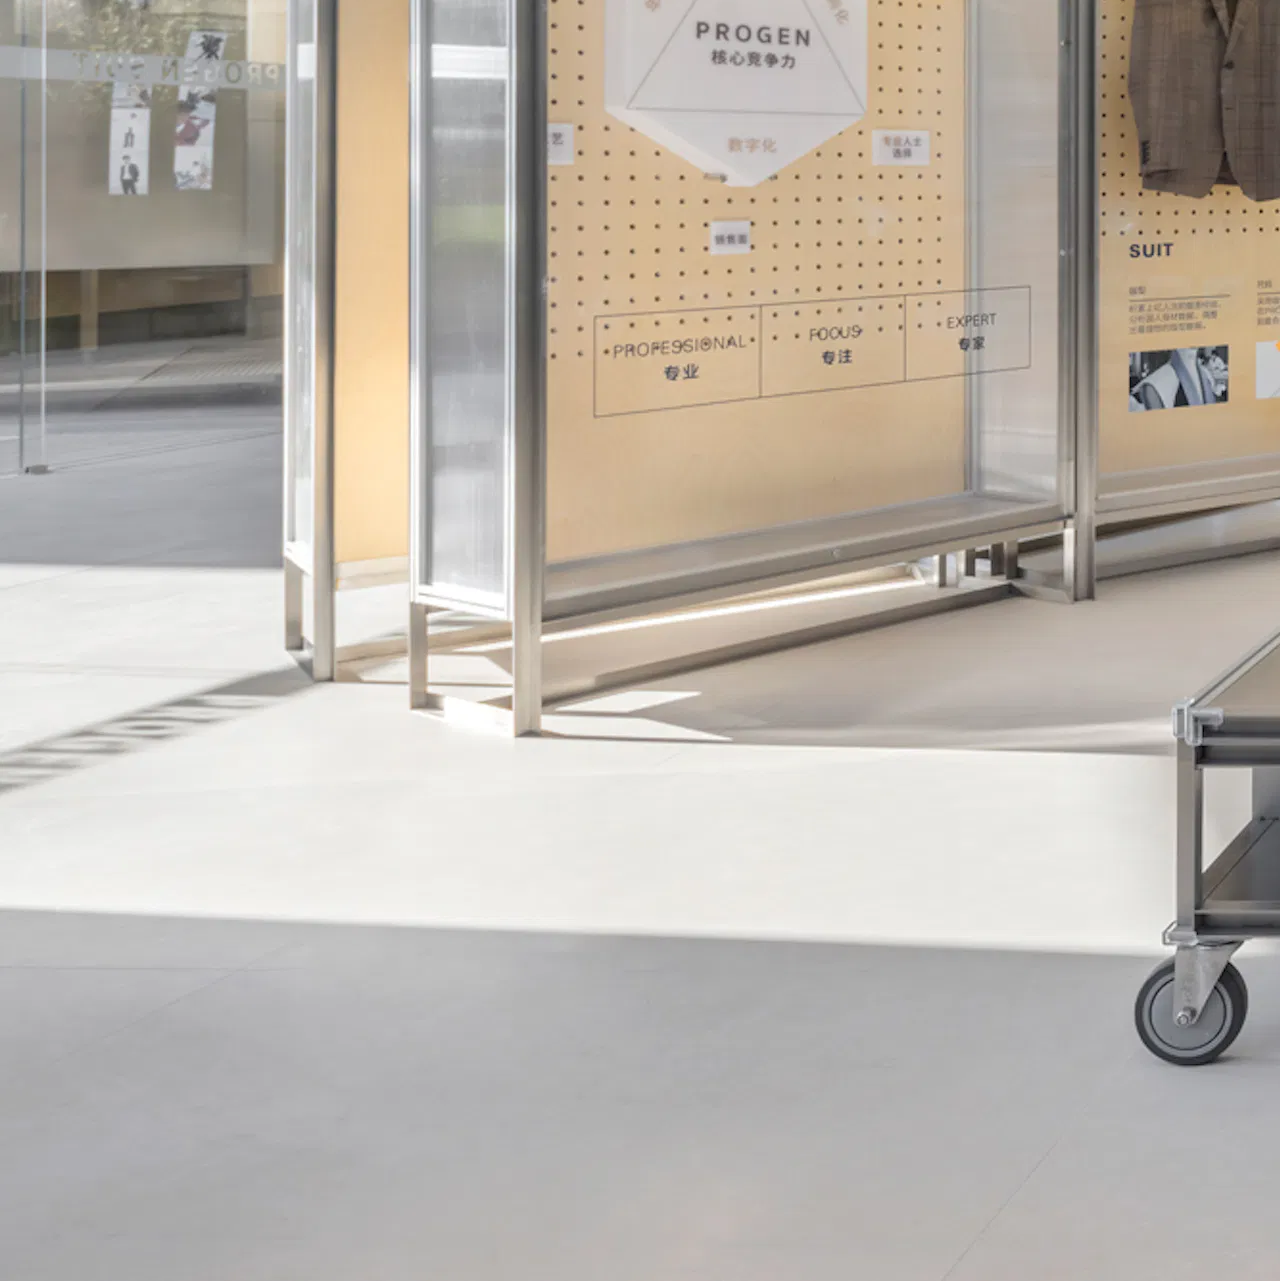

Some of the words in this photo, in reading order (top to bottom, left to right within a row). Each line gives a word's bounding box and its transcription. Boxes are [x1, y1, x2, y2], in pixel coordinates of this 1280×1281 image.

[695, 21, 813, 47] PROGEN
[711, 49, 797, 70] 核心竞争力
[726, 135, 778, 154] 数字化
[1129, 242, 1175, 259] SUIT
[946, 313, 997, 329] EXPERT
[612, 334, 747, 359] PROFESSIONAL
[957, 335, 986, 352] 专家
[821, 349, 853, 366] 专注
[663, 363, 700, 382] 专业
